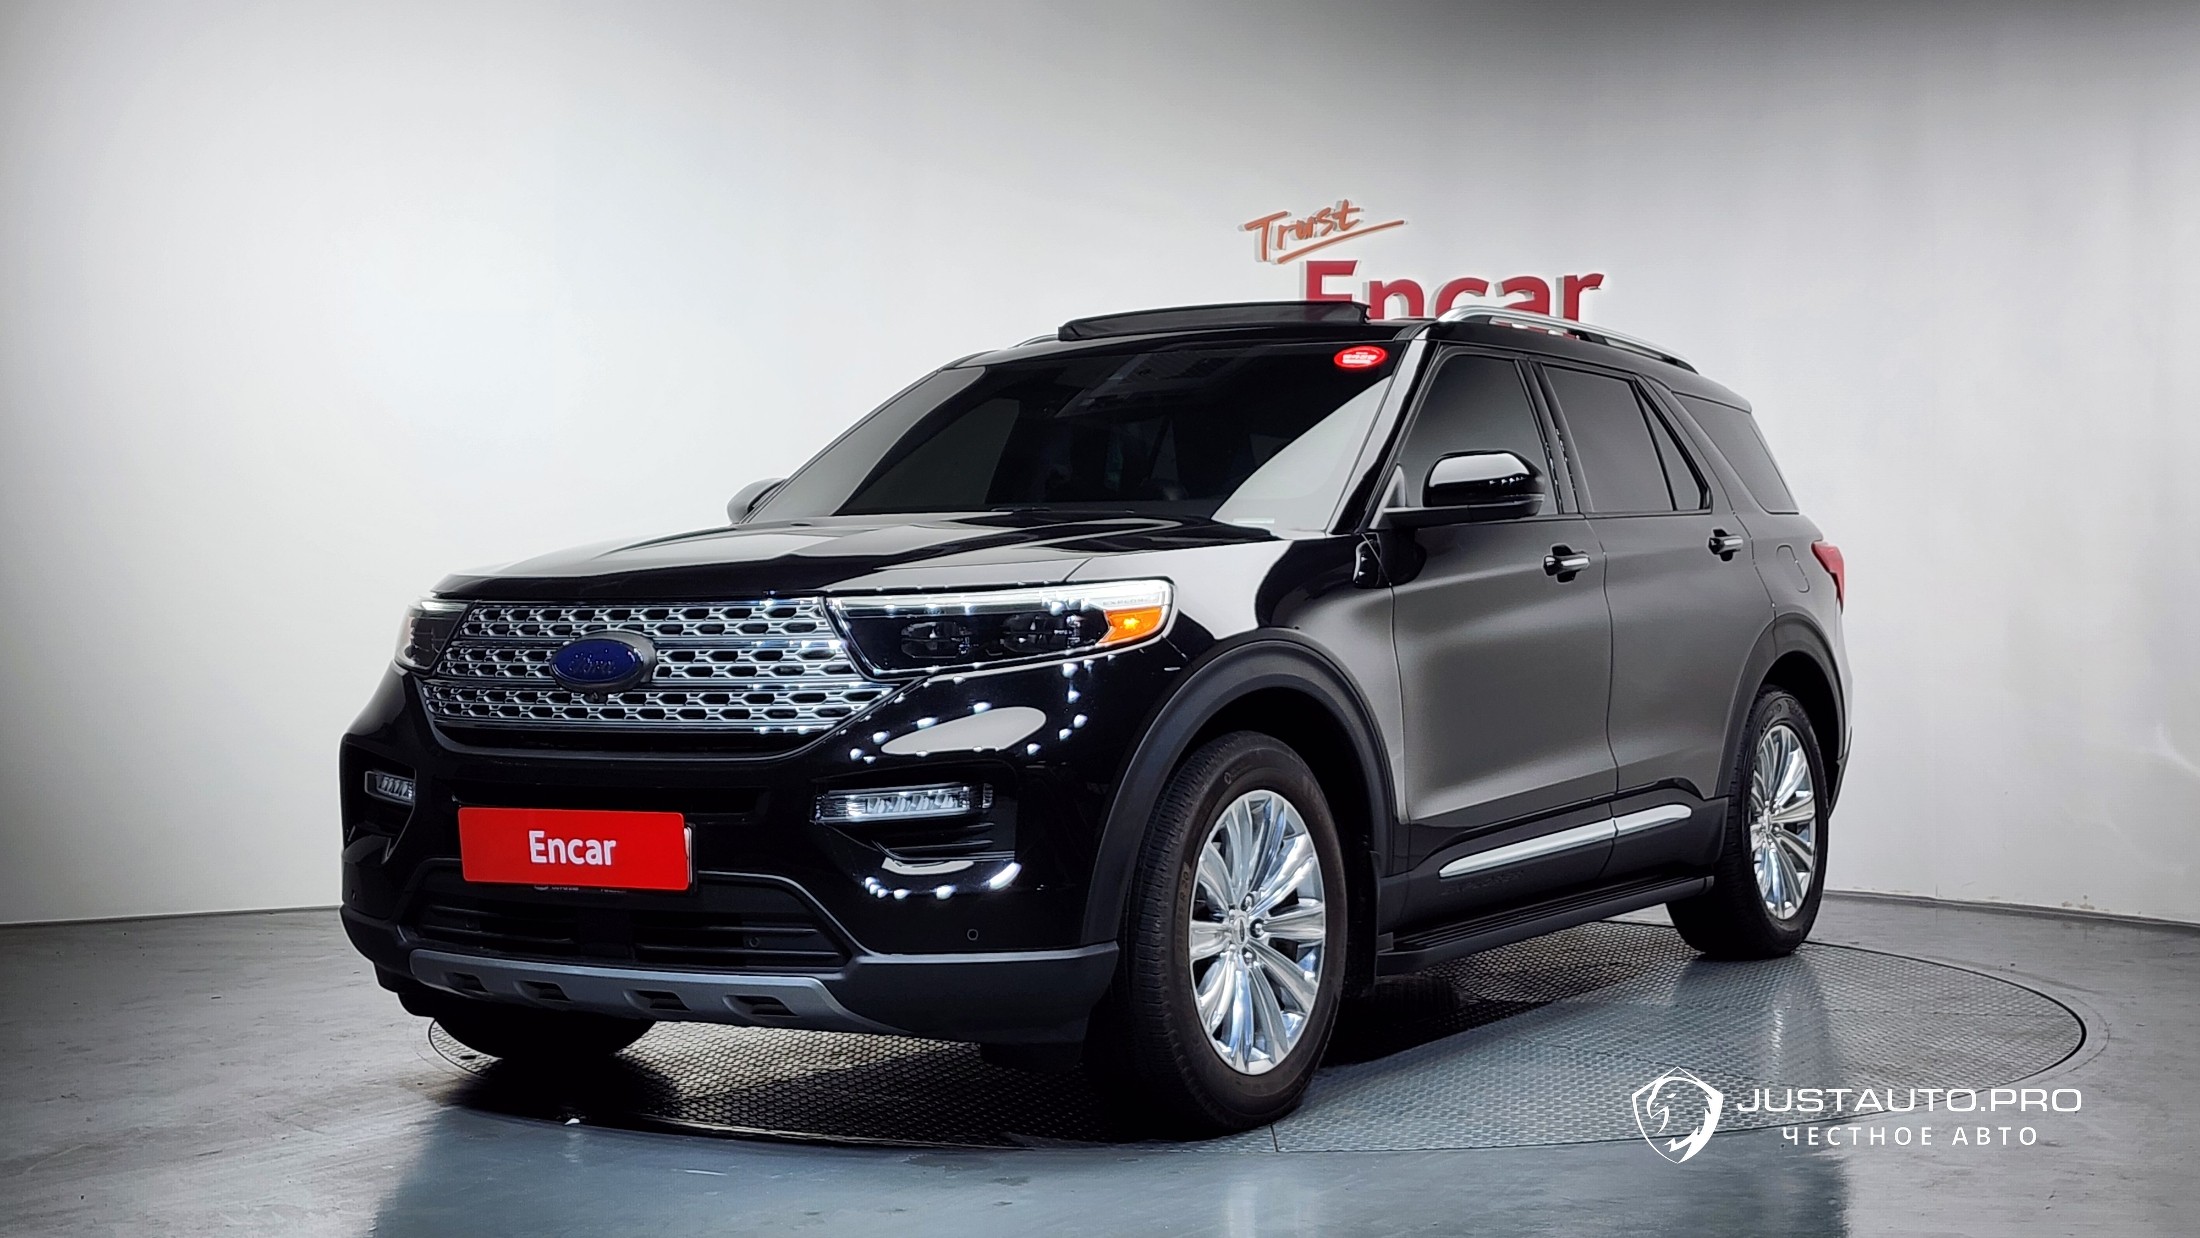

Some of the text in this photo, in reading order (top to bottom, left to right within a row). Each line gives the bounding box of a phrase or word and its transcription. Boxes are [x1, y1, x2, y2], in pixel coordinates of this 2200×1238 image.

[1244, 198, 1361, 262] Trust
[1305, 260, 1605, 323] Encar
[528, 829, 617, 866] Encar
